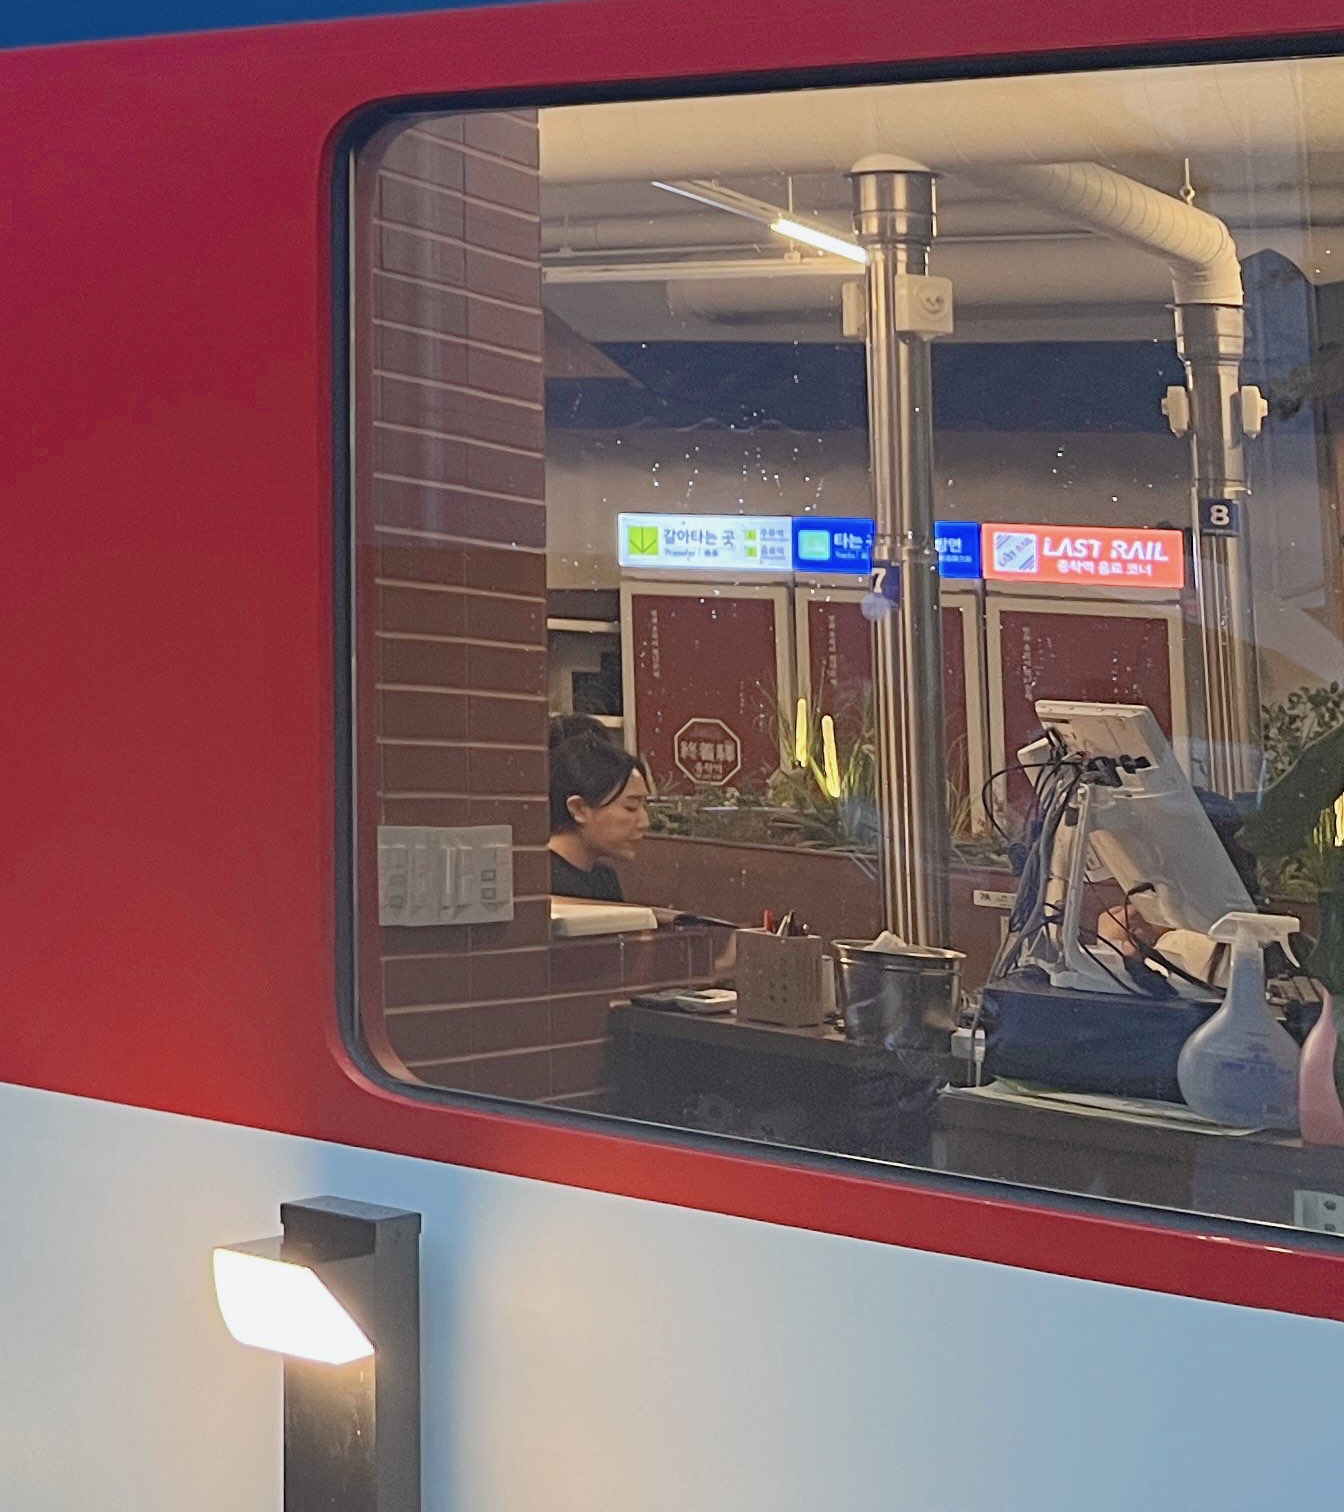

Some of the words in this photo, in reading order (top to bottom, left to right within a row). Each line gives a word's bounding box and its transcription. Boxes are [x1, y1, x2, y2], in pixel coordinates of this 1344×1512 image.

[1210, 504, 1230, 526] 8
[663, 529, 718, 547] 갈아타는
[722, 530, 736, 549] 곳
[1042, 536, 1102, 559] LAST
[1110, 539, 1169, 562] RAIL
[872, 567, 887, 593] 7
